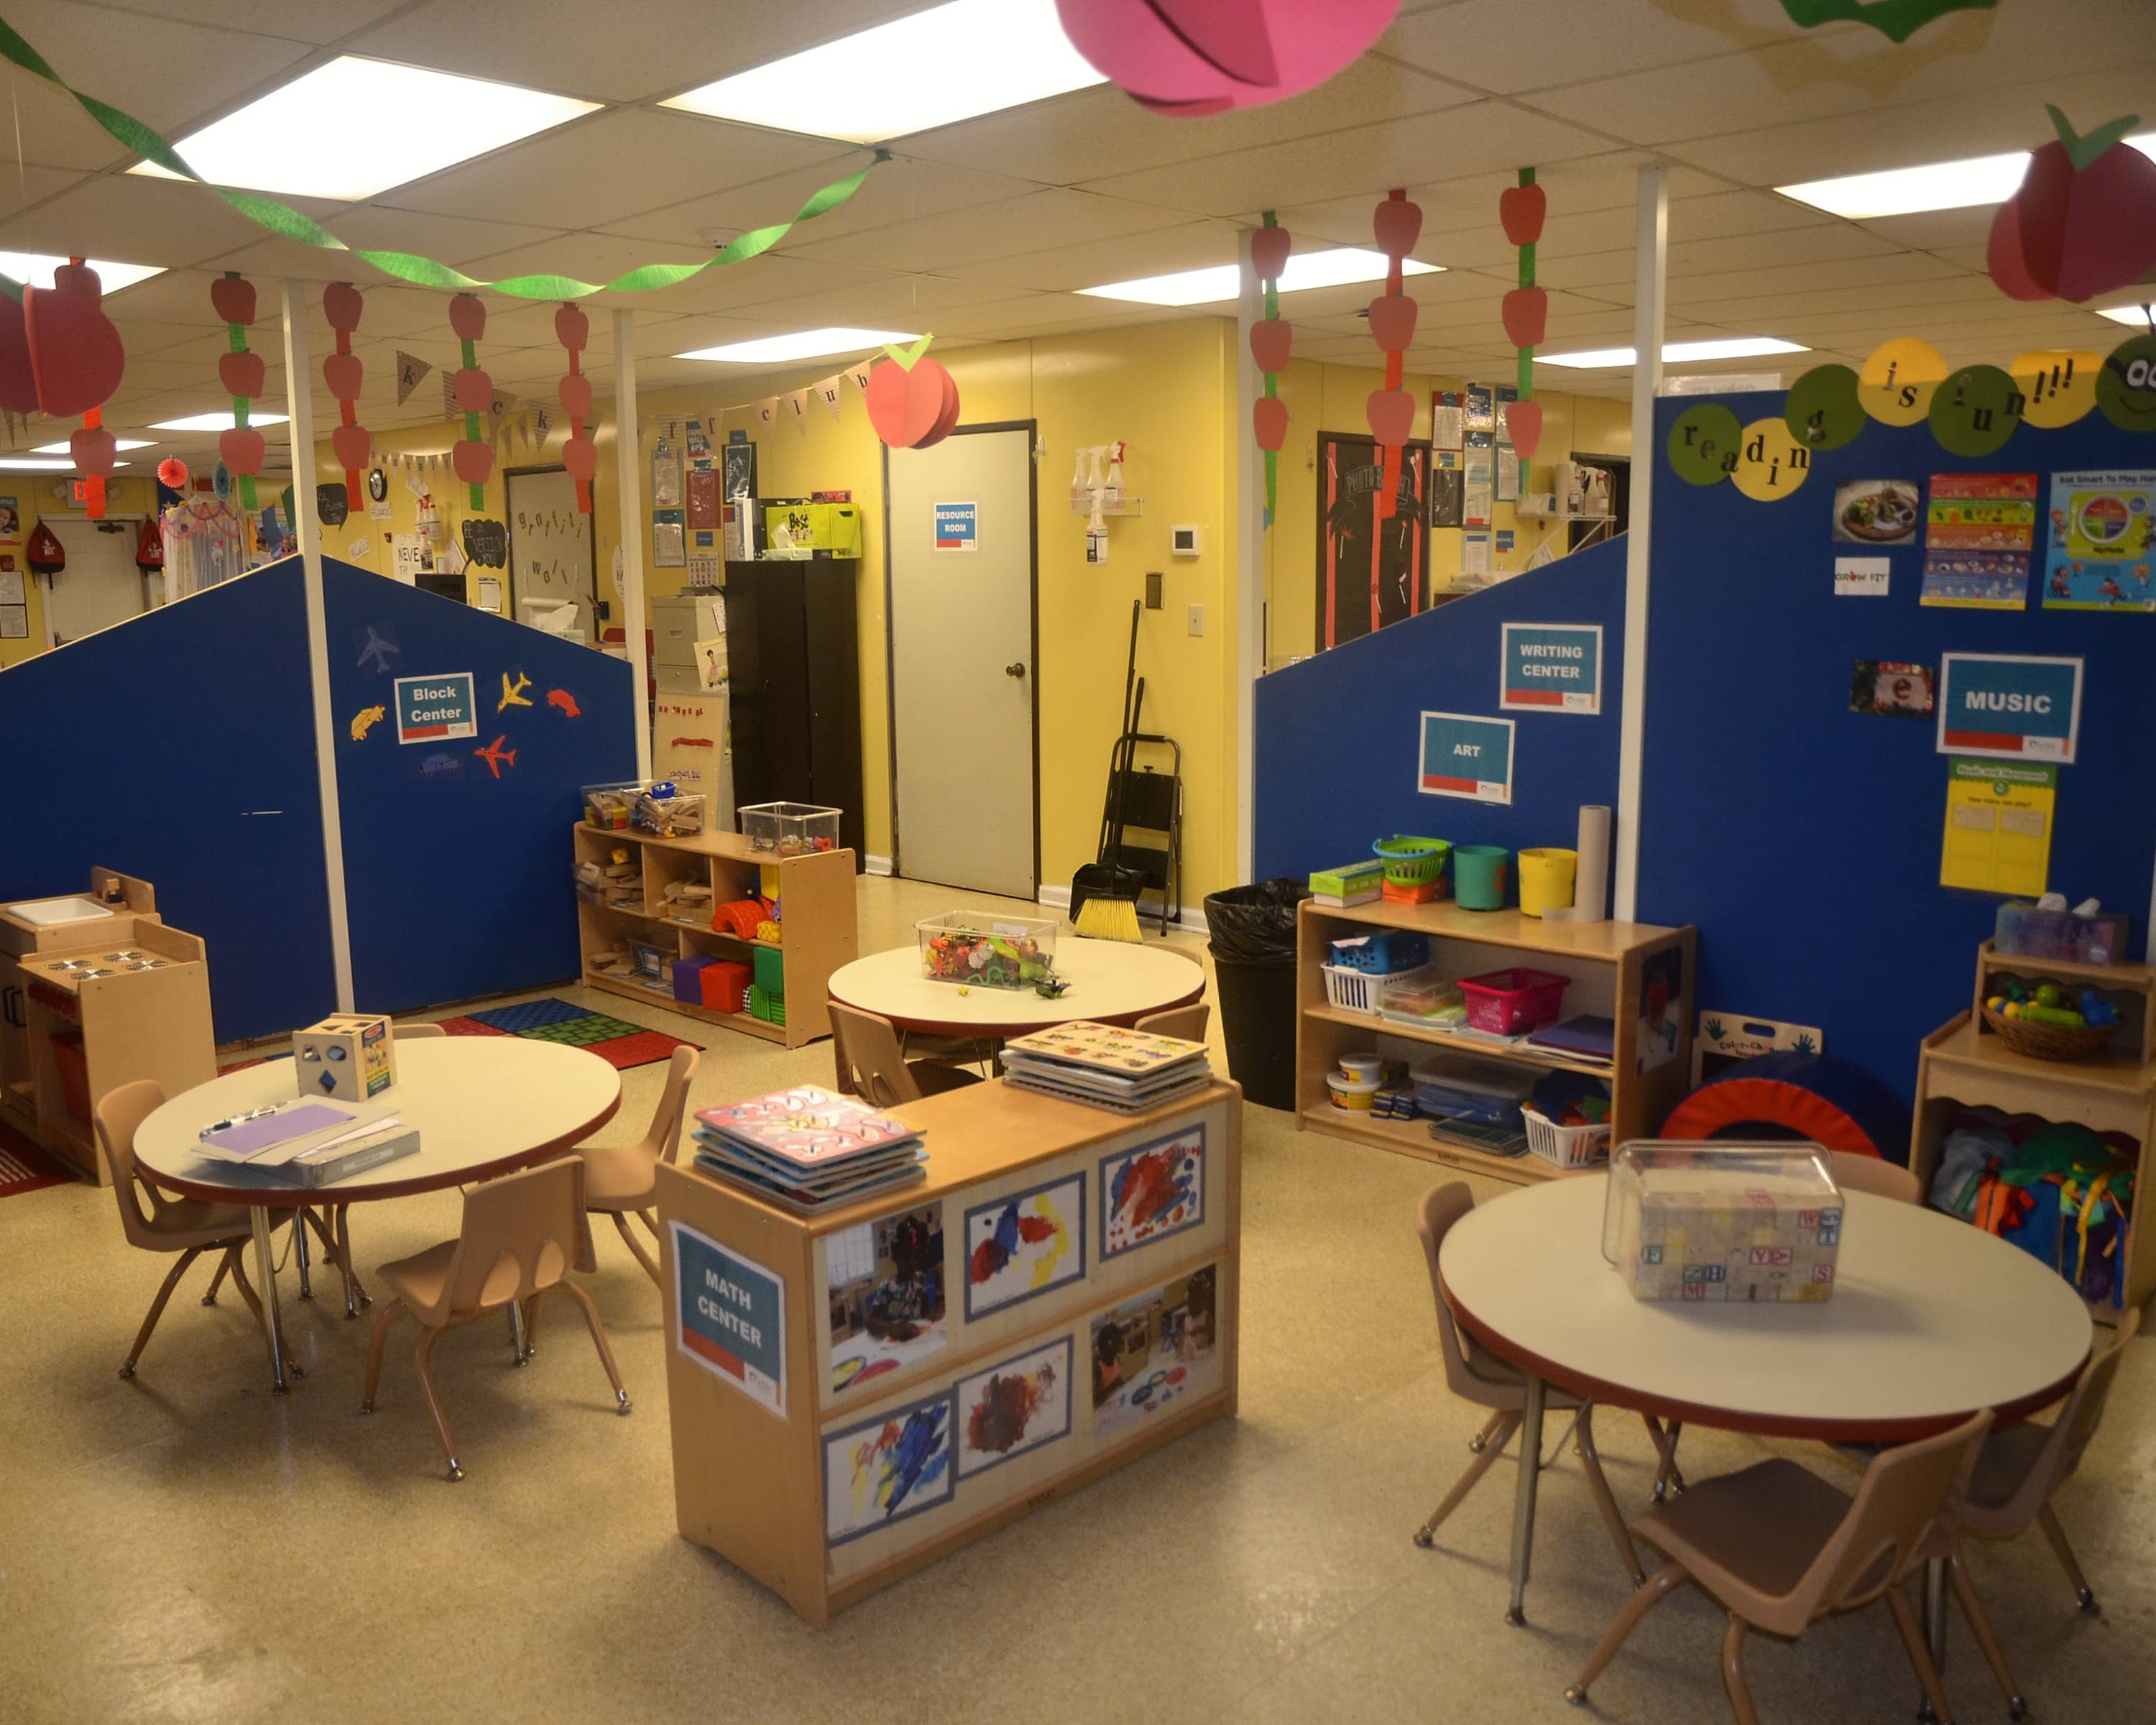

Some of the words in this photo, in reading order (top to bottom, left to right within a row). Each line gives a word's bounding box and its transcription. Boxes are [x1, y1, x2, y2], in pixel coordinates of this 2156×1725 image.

[763, 374, 867, 421] club
[1684, 410, 1825, 486] reading
[1882, 362, 1917, 408] is
[1952, 359, 2073, 431] fun!!!
[2077, 475, 2103, 484] Smart
[2119, 475, 2138, 484] Play
[936, 511, 975, 520] RESOURCE
[944, 523, 967, 533] ROOM
[398, 546, 420, 562] NEVE
[532, 559, 568, 584] wall
[1870, 573, 1886, 582] FIT
[1520, 644, 1583, 658] WRITING
[1522, 664, 1580, 678] CENTER
[413, 686, 456, 701] Block
[1965, 691, 2052, 714] MUSIC
[411, 708, 462, 722] Center
[1452, 743, 1481, 758] ART
[705, 1268, 752, 1311] MATH
[697, 1294, 763, 1348] CENTER
